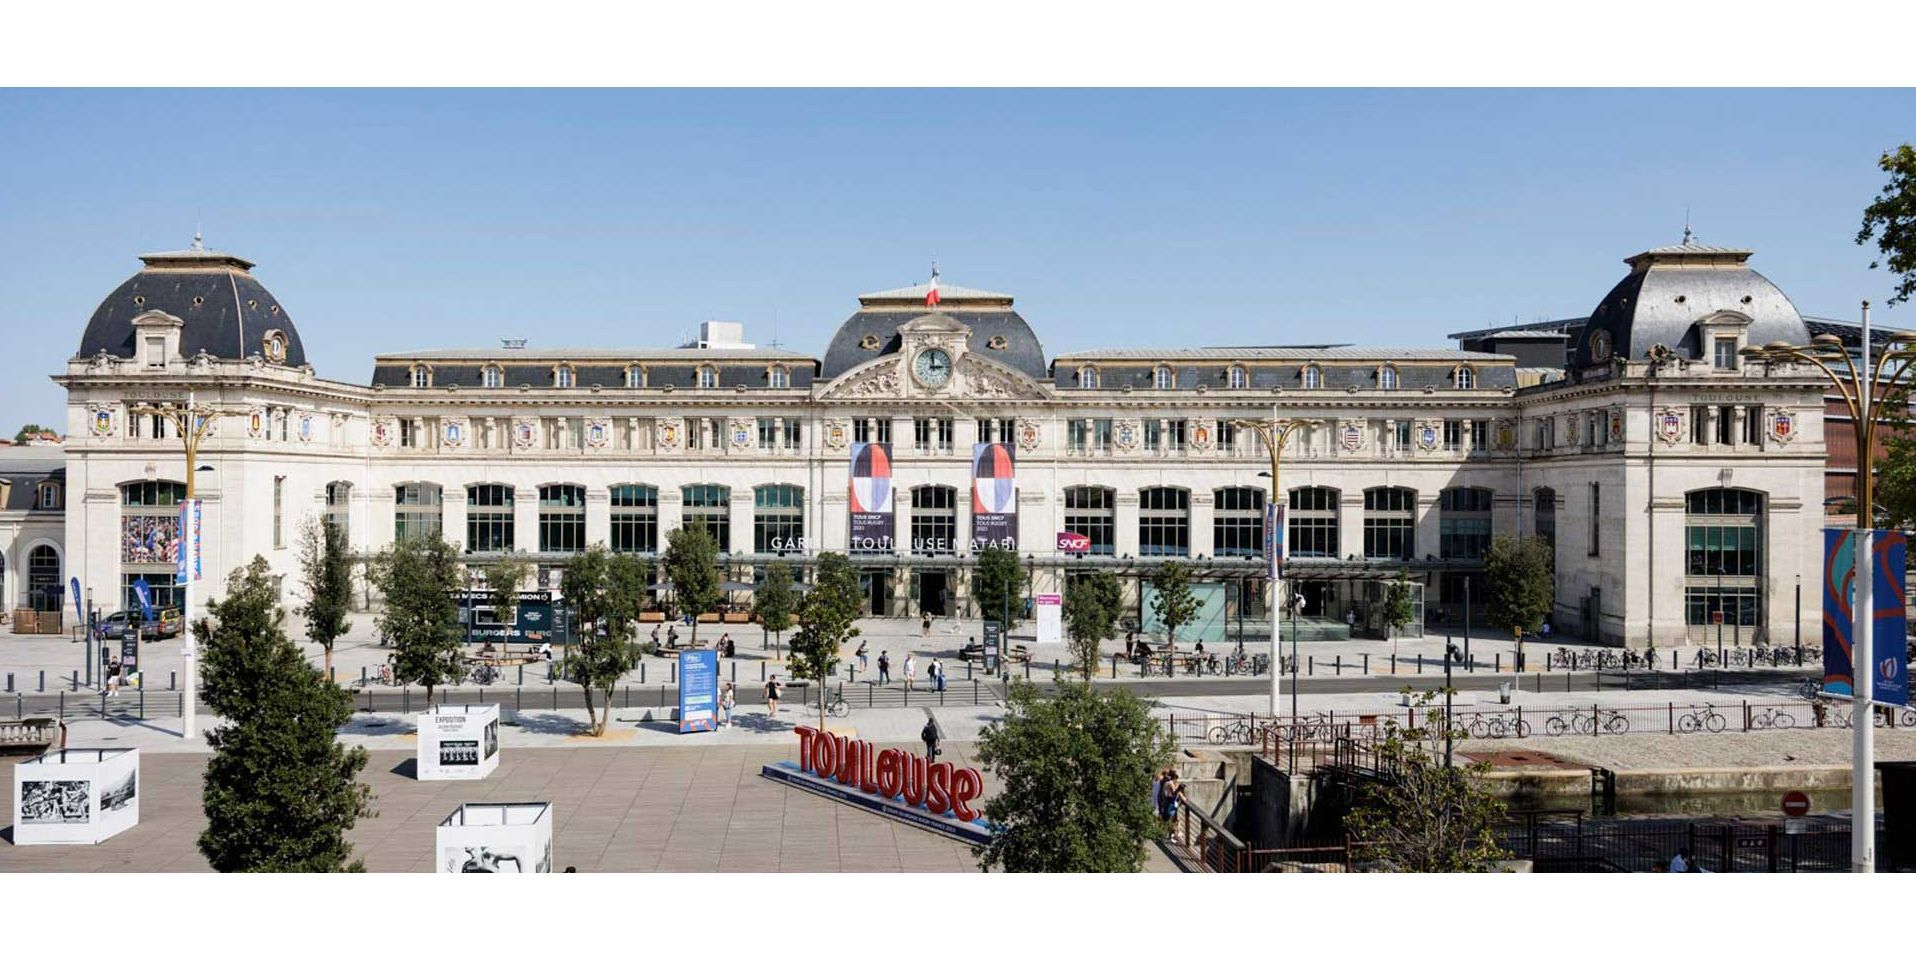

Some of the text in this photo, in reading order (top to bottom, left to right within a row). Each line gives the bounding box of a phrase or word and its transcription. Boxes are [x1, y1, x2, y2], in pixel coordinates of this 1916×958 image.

[1693, 392, 1759, 401] TOULOUSE
[851, 537, 945, 550] TOULUSE
[1058, 539, 1088, 549] SNCF
[471, 629, 521, 637] BURGERS
[435, 716, 466, 724] EXPOSITION
